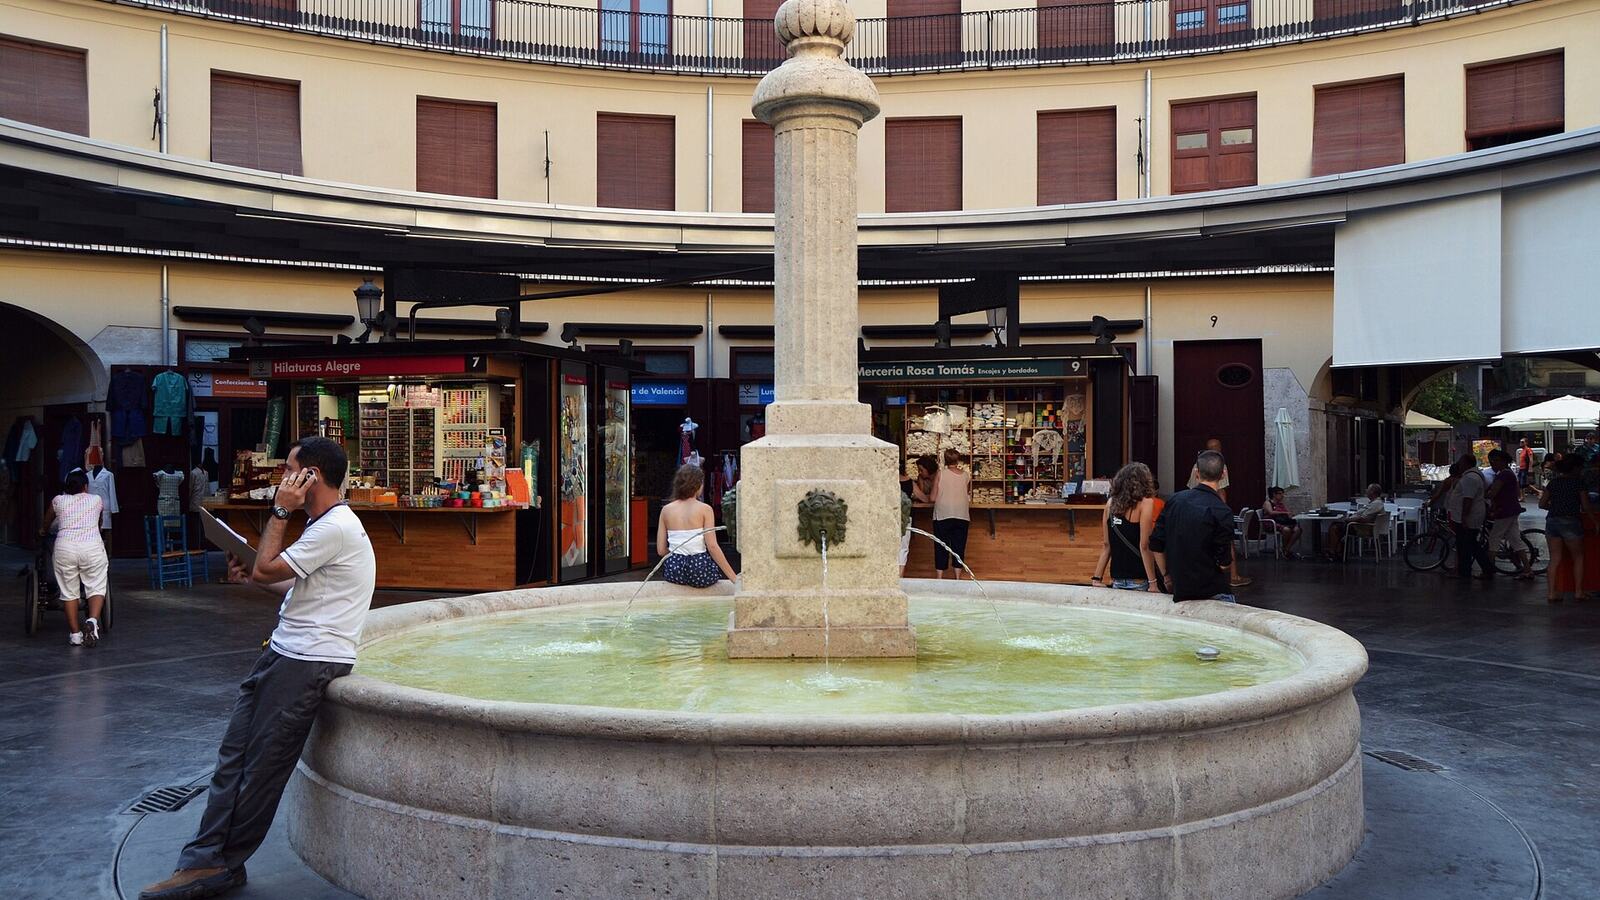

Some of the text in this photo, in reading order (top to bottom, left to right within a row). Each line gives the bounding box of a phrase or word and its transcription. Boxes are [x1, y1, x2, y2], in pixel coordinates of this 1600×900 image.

[1210, 315, 1218, 327] 9
[274, 360, 361, 374] Hilaturas Alegre
[472, 356, 480, 368] 7
[1071, 361, 1080, 372] 9
[857, 365, 903, 376] Mercería
[906, 365, 935, 376] Rosa
[937, 364, 975, 375] Tomás
[978, 367, 1001, 375] Encajes
[638, 387, 649, 395] de
[650, 387, 685, 395] Valencia
